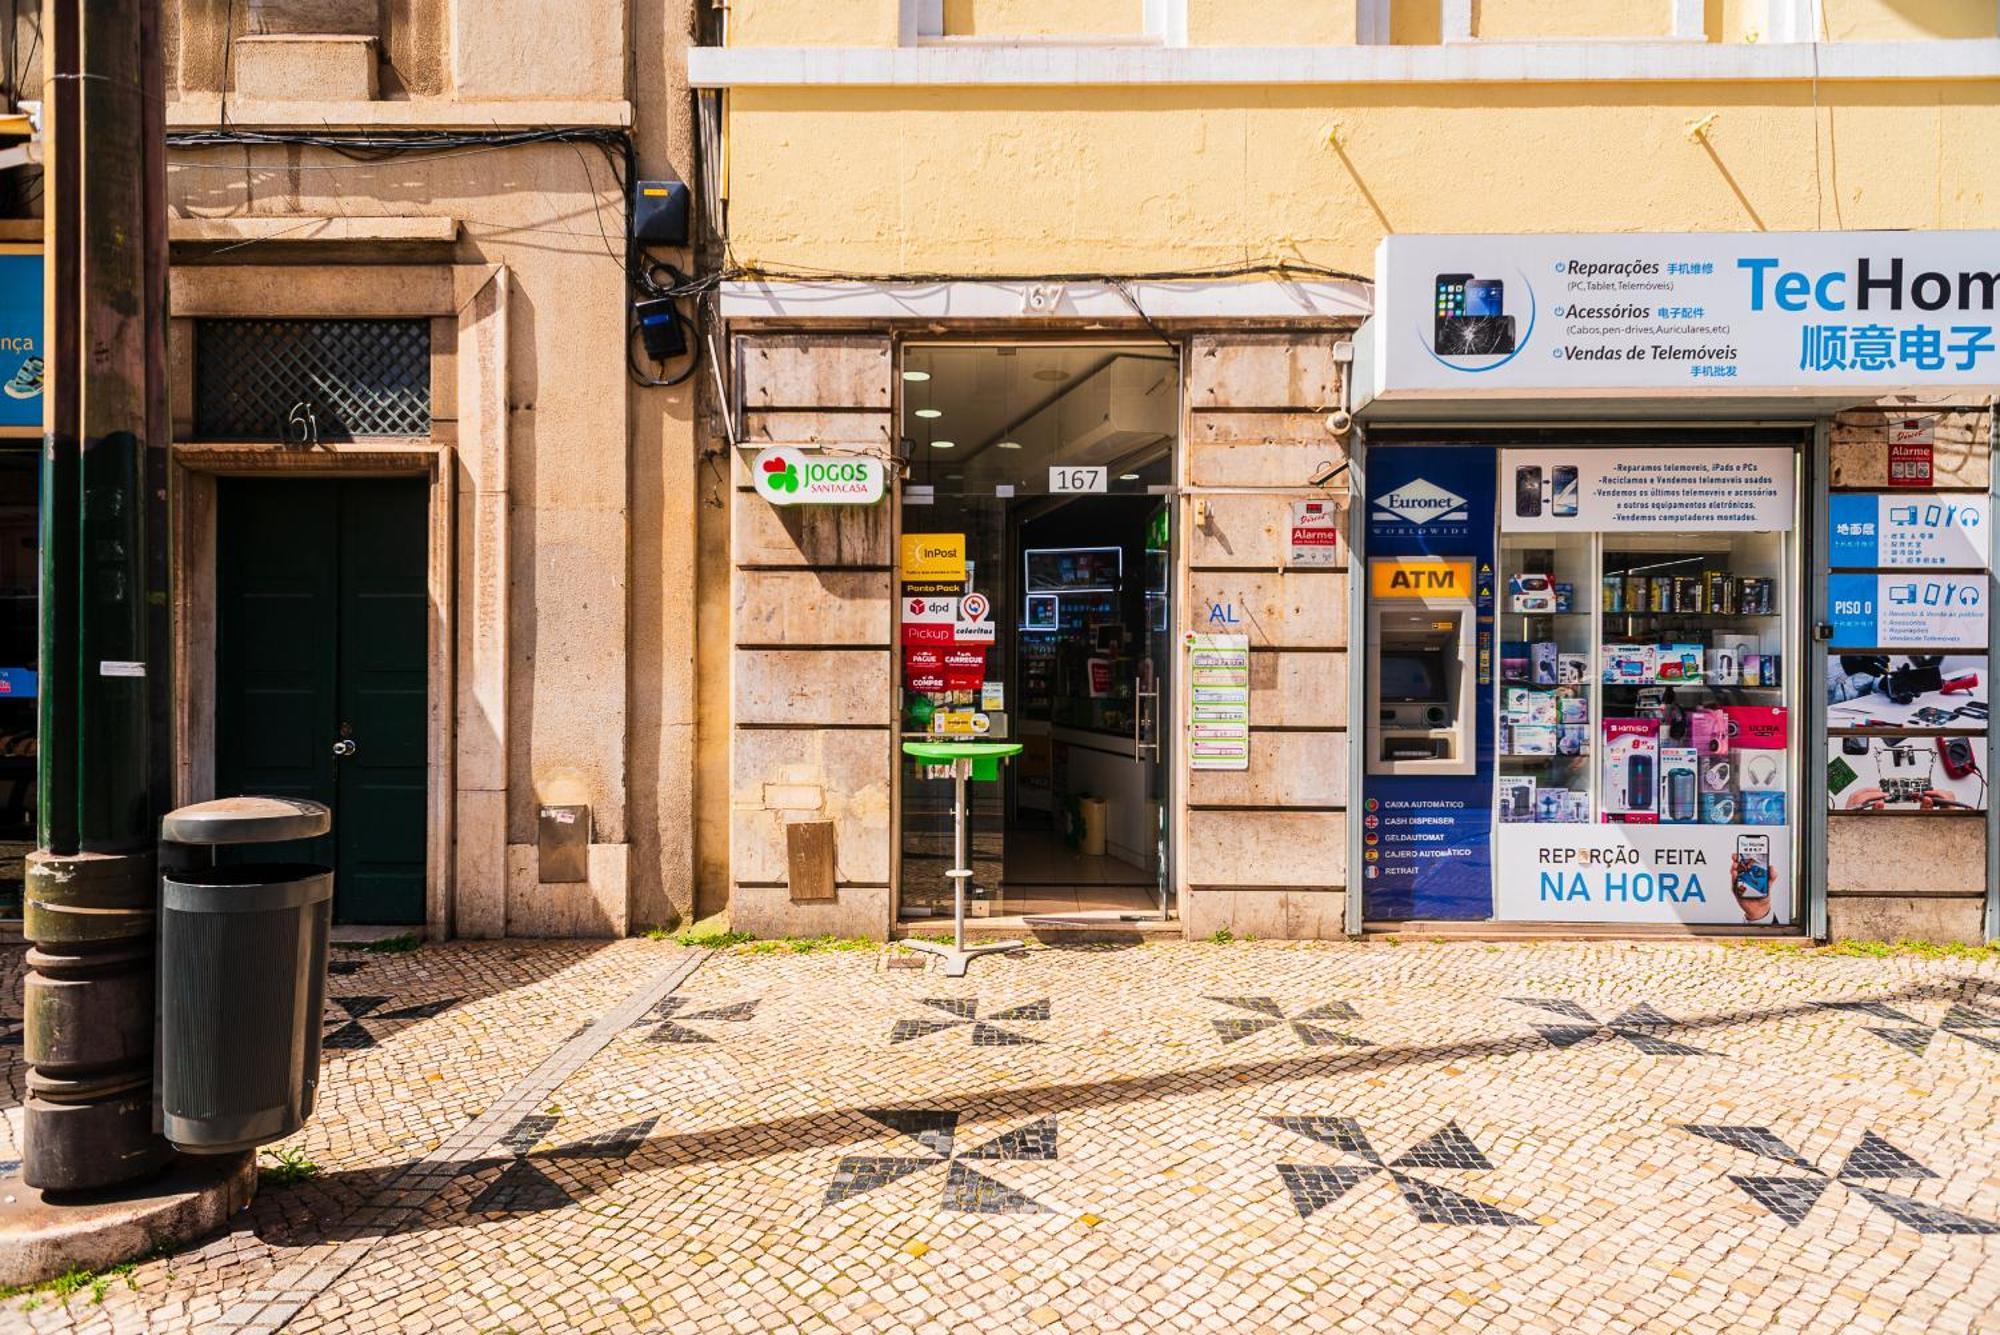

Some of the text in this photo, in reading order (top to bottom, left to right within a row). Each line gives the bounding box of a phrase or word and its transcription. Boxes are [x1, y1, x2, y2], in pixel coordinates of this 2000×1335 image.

[1568, 260, 1659, 277] Reparações
[1667, 262, 1713, 275] 手机维修
[1565, 304, 1650, 319] Acessórios
[1657, 307, 1705, 319] 电子配件
[1564, 344, 1737, 360] Vendas de Telemóveis
[1800, 324, 1995, 372] 顺意电子
[1690, 365, 1737, 377] 手机批发
[1892, 446, 1930, 456] Alarme
[1743, 464, 1757, 472] PCs
[804, 463, 868, 488] JOGOS
[1057, 470, 1099, 490] 167
[1656, 476, 1697, 484] Vendemos
[1388, 494, 1453, 509] Euronet
[1623, 501, 1649, 509] outros
[1651, 502, 1706, 511] equipamentos
[1658, 514, 1714, 522] computadores
[1294, 529, 1334, 539] Alarme
[924, 548, 957, 559] InPost
[1390, 570, 1455, 589] ATM
[907, 584, 935, 592] Ponto
[929, 603, 949, 614] dpd
[1209, 603, 1240, 623] AL
[1835, 601, 1860, 615] PISO
[908, 628, 949, 640] Pickup
[1409, 817, 1455, 825] DISPENSER
[1539, 845, 1707, 868] REPRÇÃO FEITA
[1385, 867, 1419, 875] RETRAIT
[1540, 872, 1706, 902] NA HORA
